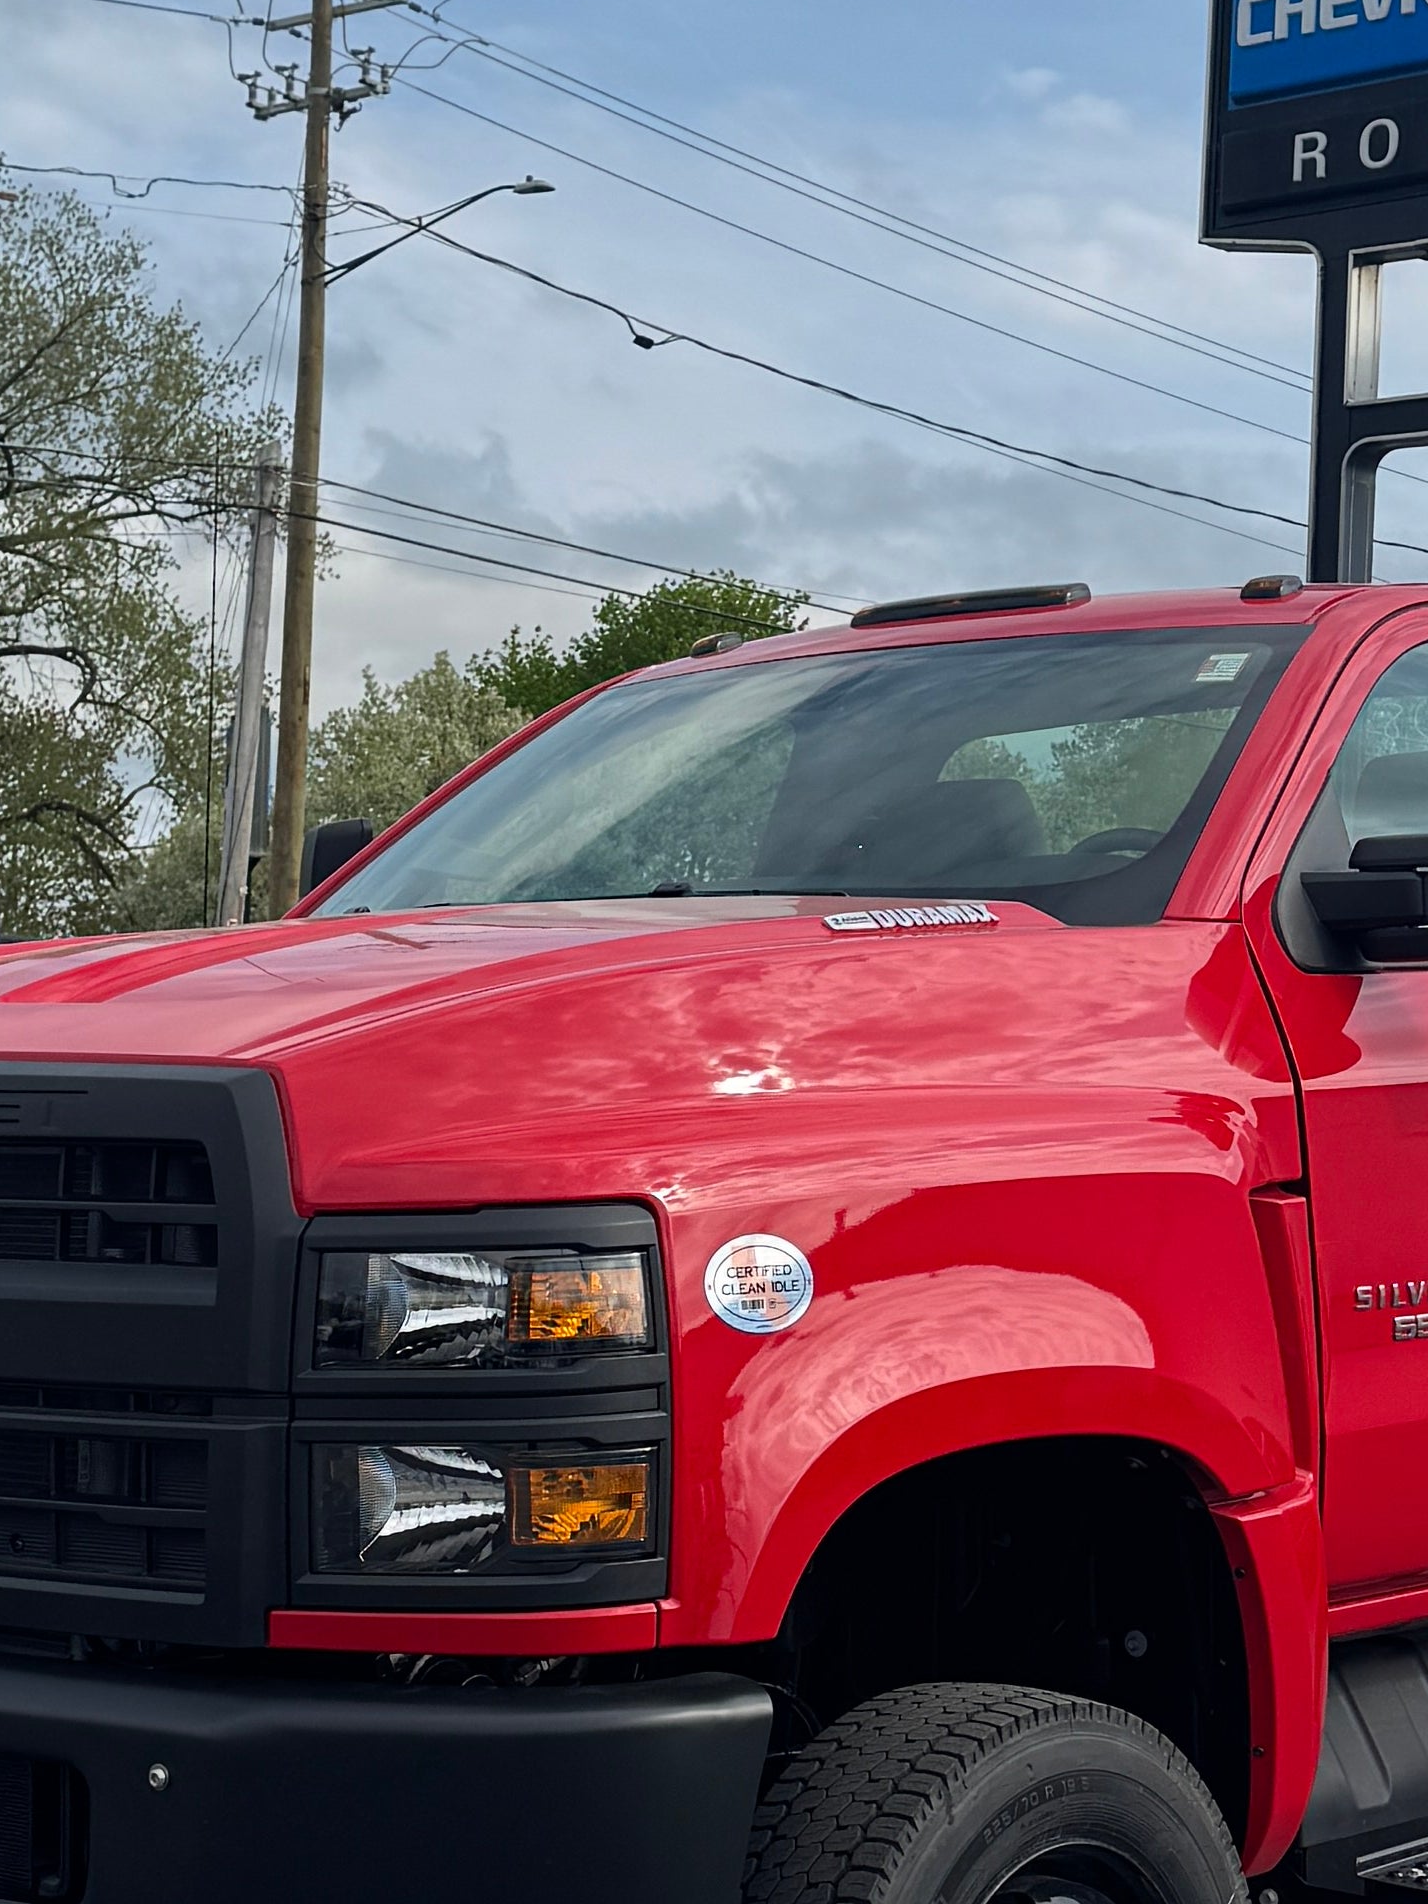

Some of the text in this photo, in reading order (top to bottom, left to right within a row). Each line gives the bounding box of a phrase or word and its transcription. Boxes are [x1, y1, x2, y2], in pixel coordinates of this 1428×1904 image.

[871, 904, 1000, 928] DURAMAX
[726, 1264, 793, 1279] CERTIFIED
[722, 1280, 800, 1296] CLEAN IDLE
